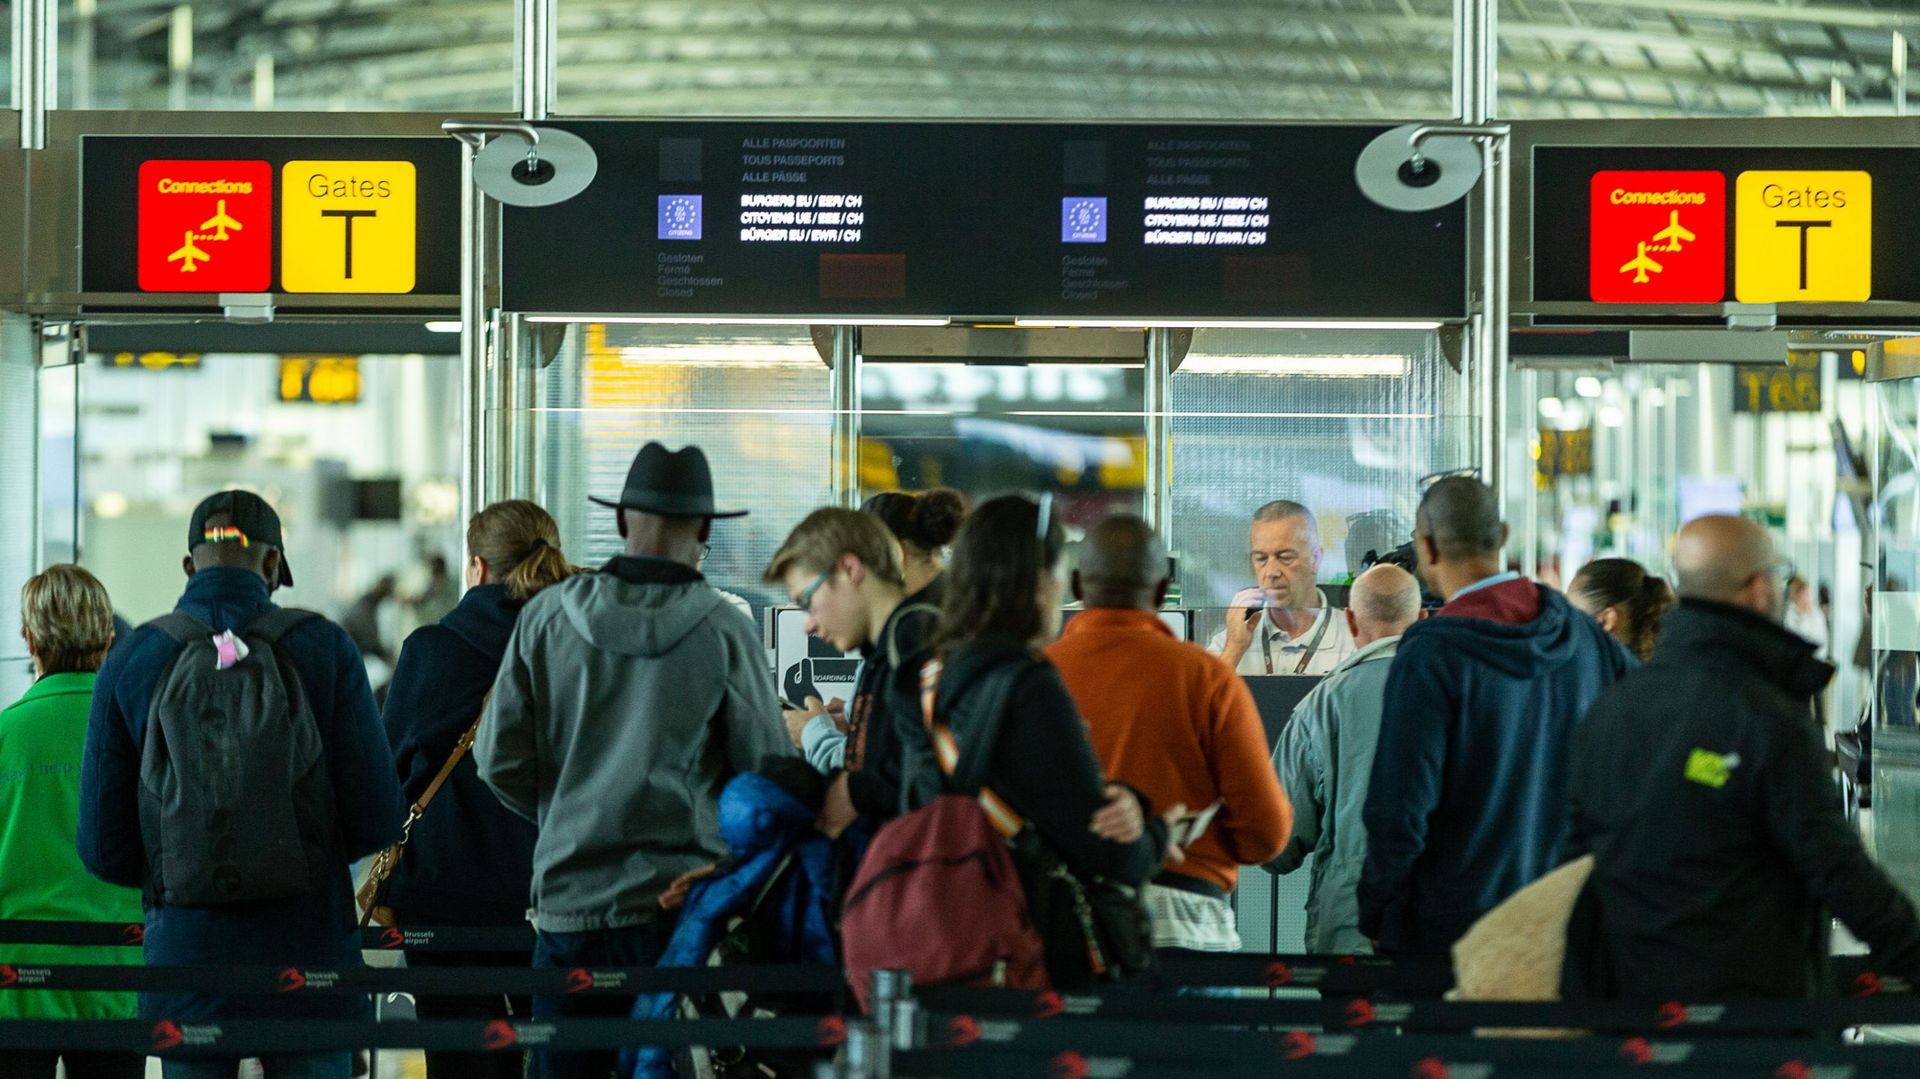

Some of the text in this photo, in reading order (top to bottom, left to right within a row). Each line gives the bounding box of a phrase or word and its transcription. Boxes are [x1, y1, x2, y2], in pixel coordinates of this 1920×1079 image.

[742, 138, 846, 149] ALLE PASPOORTEN
[742, 155, 845, 166] TOUS PASSEPORTS
[742, 172, 770, 182] ALLE
[158, 178, 253, 194] Connections
[308, 173, 392, 198] Gates
[740, 194, 795, 207] BURGERS
[796, 195, 812, 207] EU
[845, 195, 863, 207] CH
[1610, 188, 1706, 205] Connections
[1762, 183, 1846, 209] Gates
[1200, 197, 1218, 210] EU
[1249, 197, 1268, 210] CH
[740, 211, 795, 224] CITOYENS
[795, 212, 812, 224] UE
[846, 212, 864, 224] CH
[1250, 214, 1269, 228] CH
[740, 227, 788, 241] BÜRGER
[789, 229, 805, 241] EU
[811, 229, 838, 242] EWR
[843, 229, 861, 242] CH
[1247, 231, 1267, 245] CH
[321, 209, 377, 279] T
[657, 252, 703, 263] Gesloten
[1776, 220, 1832, 290] T
[657, 275, 723, 286] Geschlossen
[657, 286, 693, 297] Closed
[814, 674, 847, 682] BOARDING
[404, 930, 434, 938] brussels
